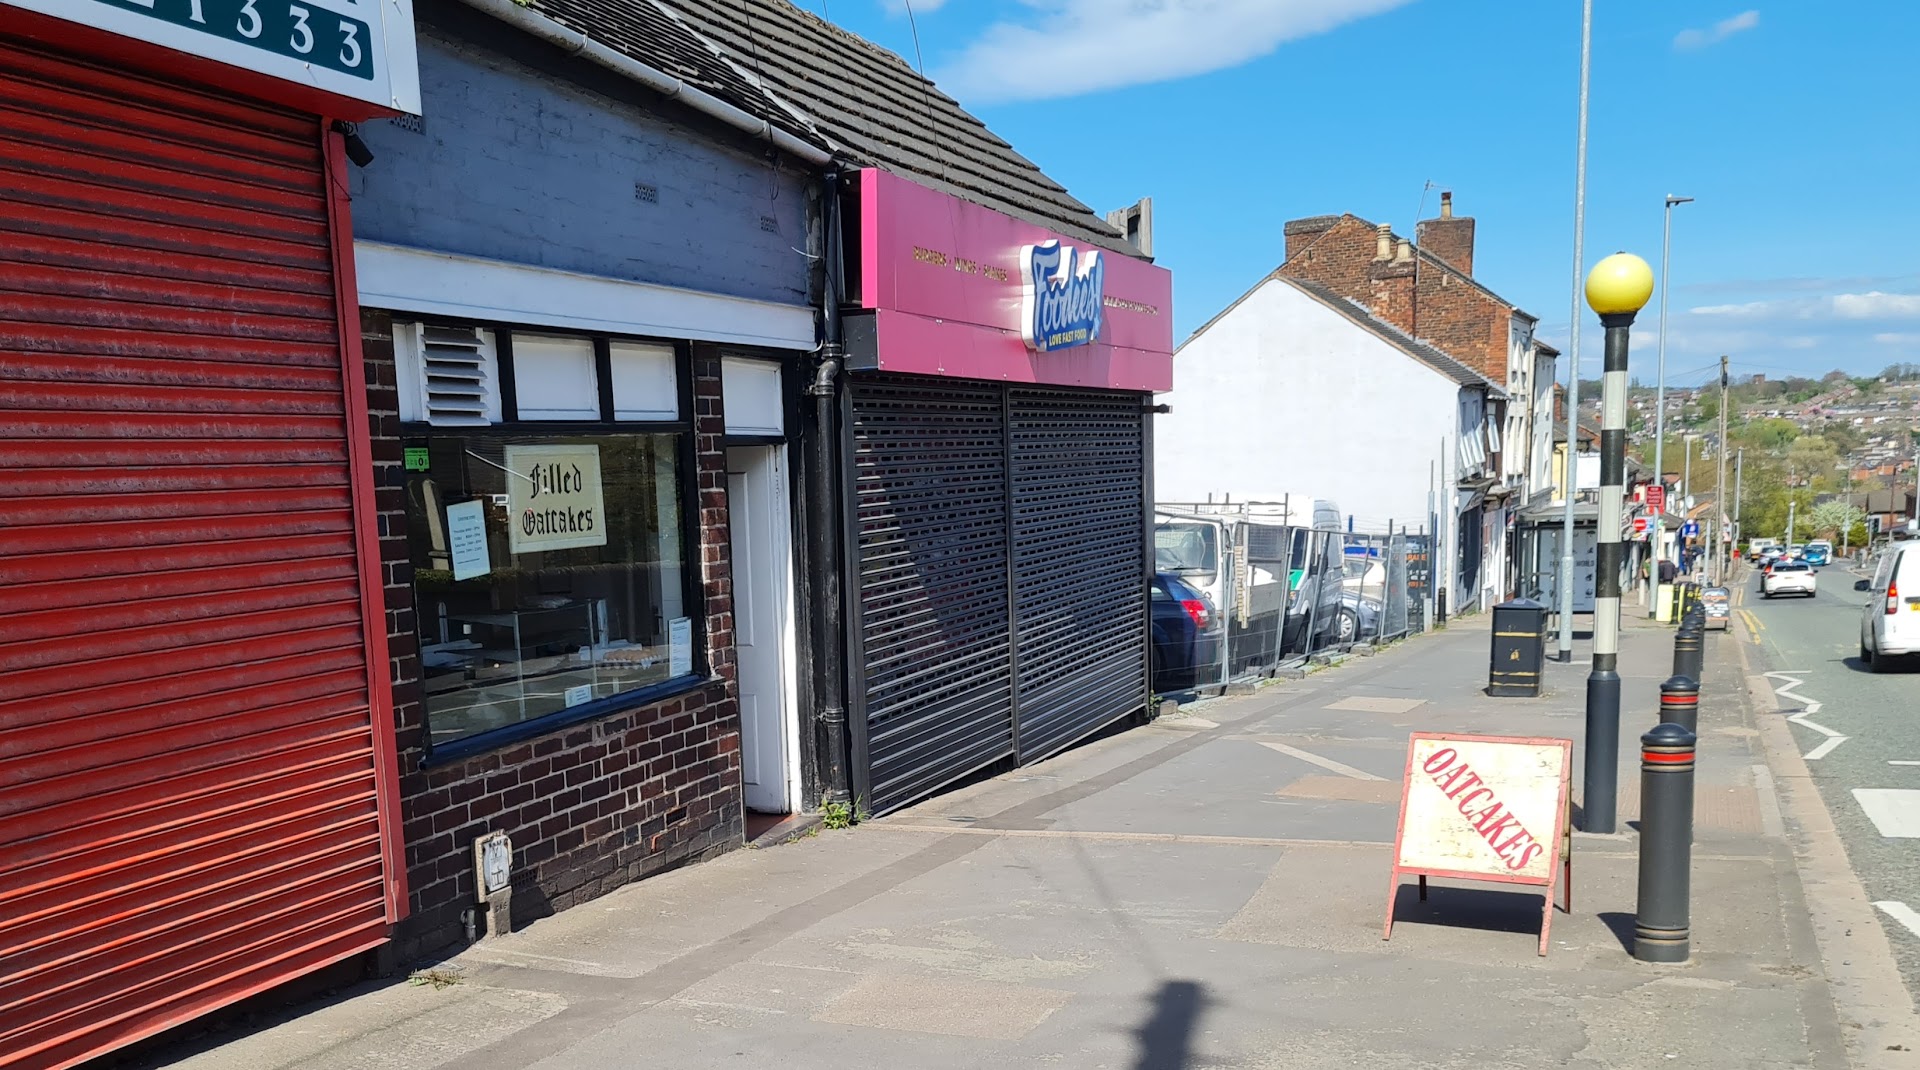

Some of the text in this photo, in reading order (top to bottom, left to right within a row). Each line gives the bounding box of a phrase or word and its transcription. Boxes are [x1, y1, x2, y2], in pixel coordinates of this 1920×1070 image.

[1048, 328, 1087, 347] LOVE FAST FOOD
[529, 462, 582, 500] Filled
[522, 505, 593, 537] Oatcakes
[1422, 747, 1544, 872] OATCAKES
